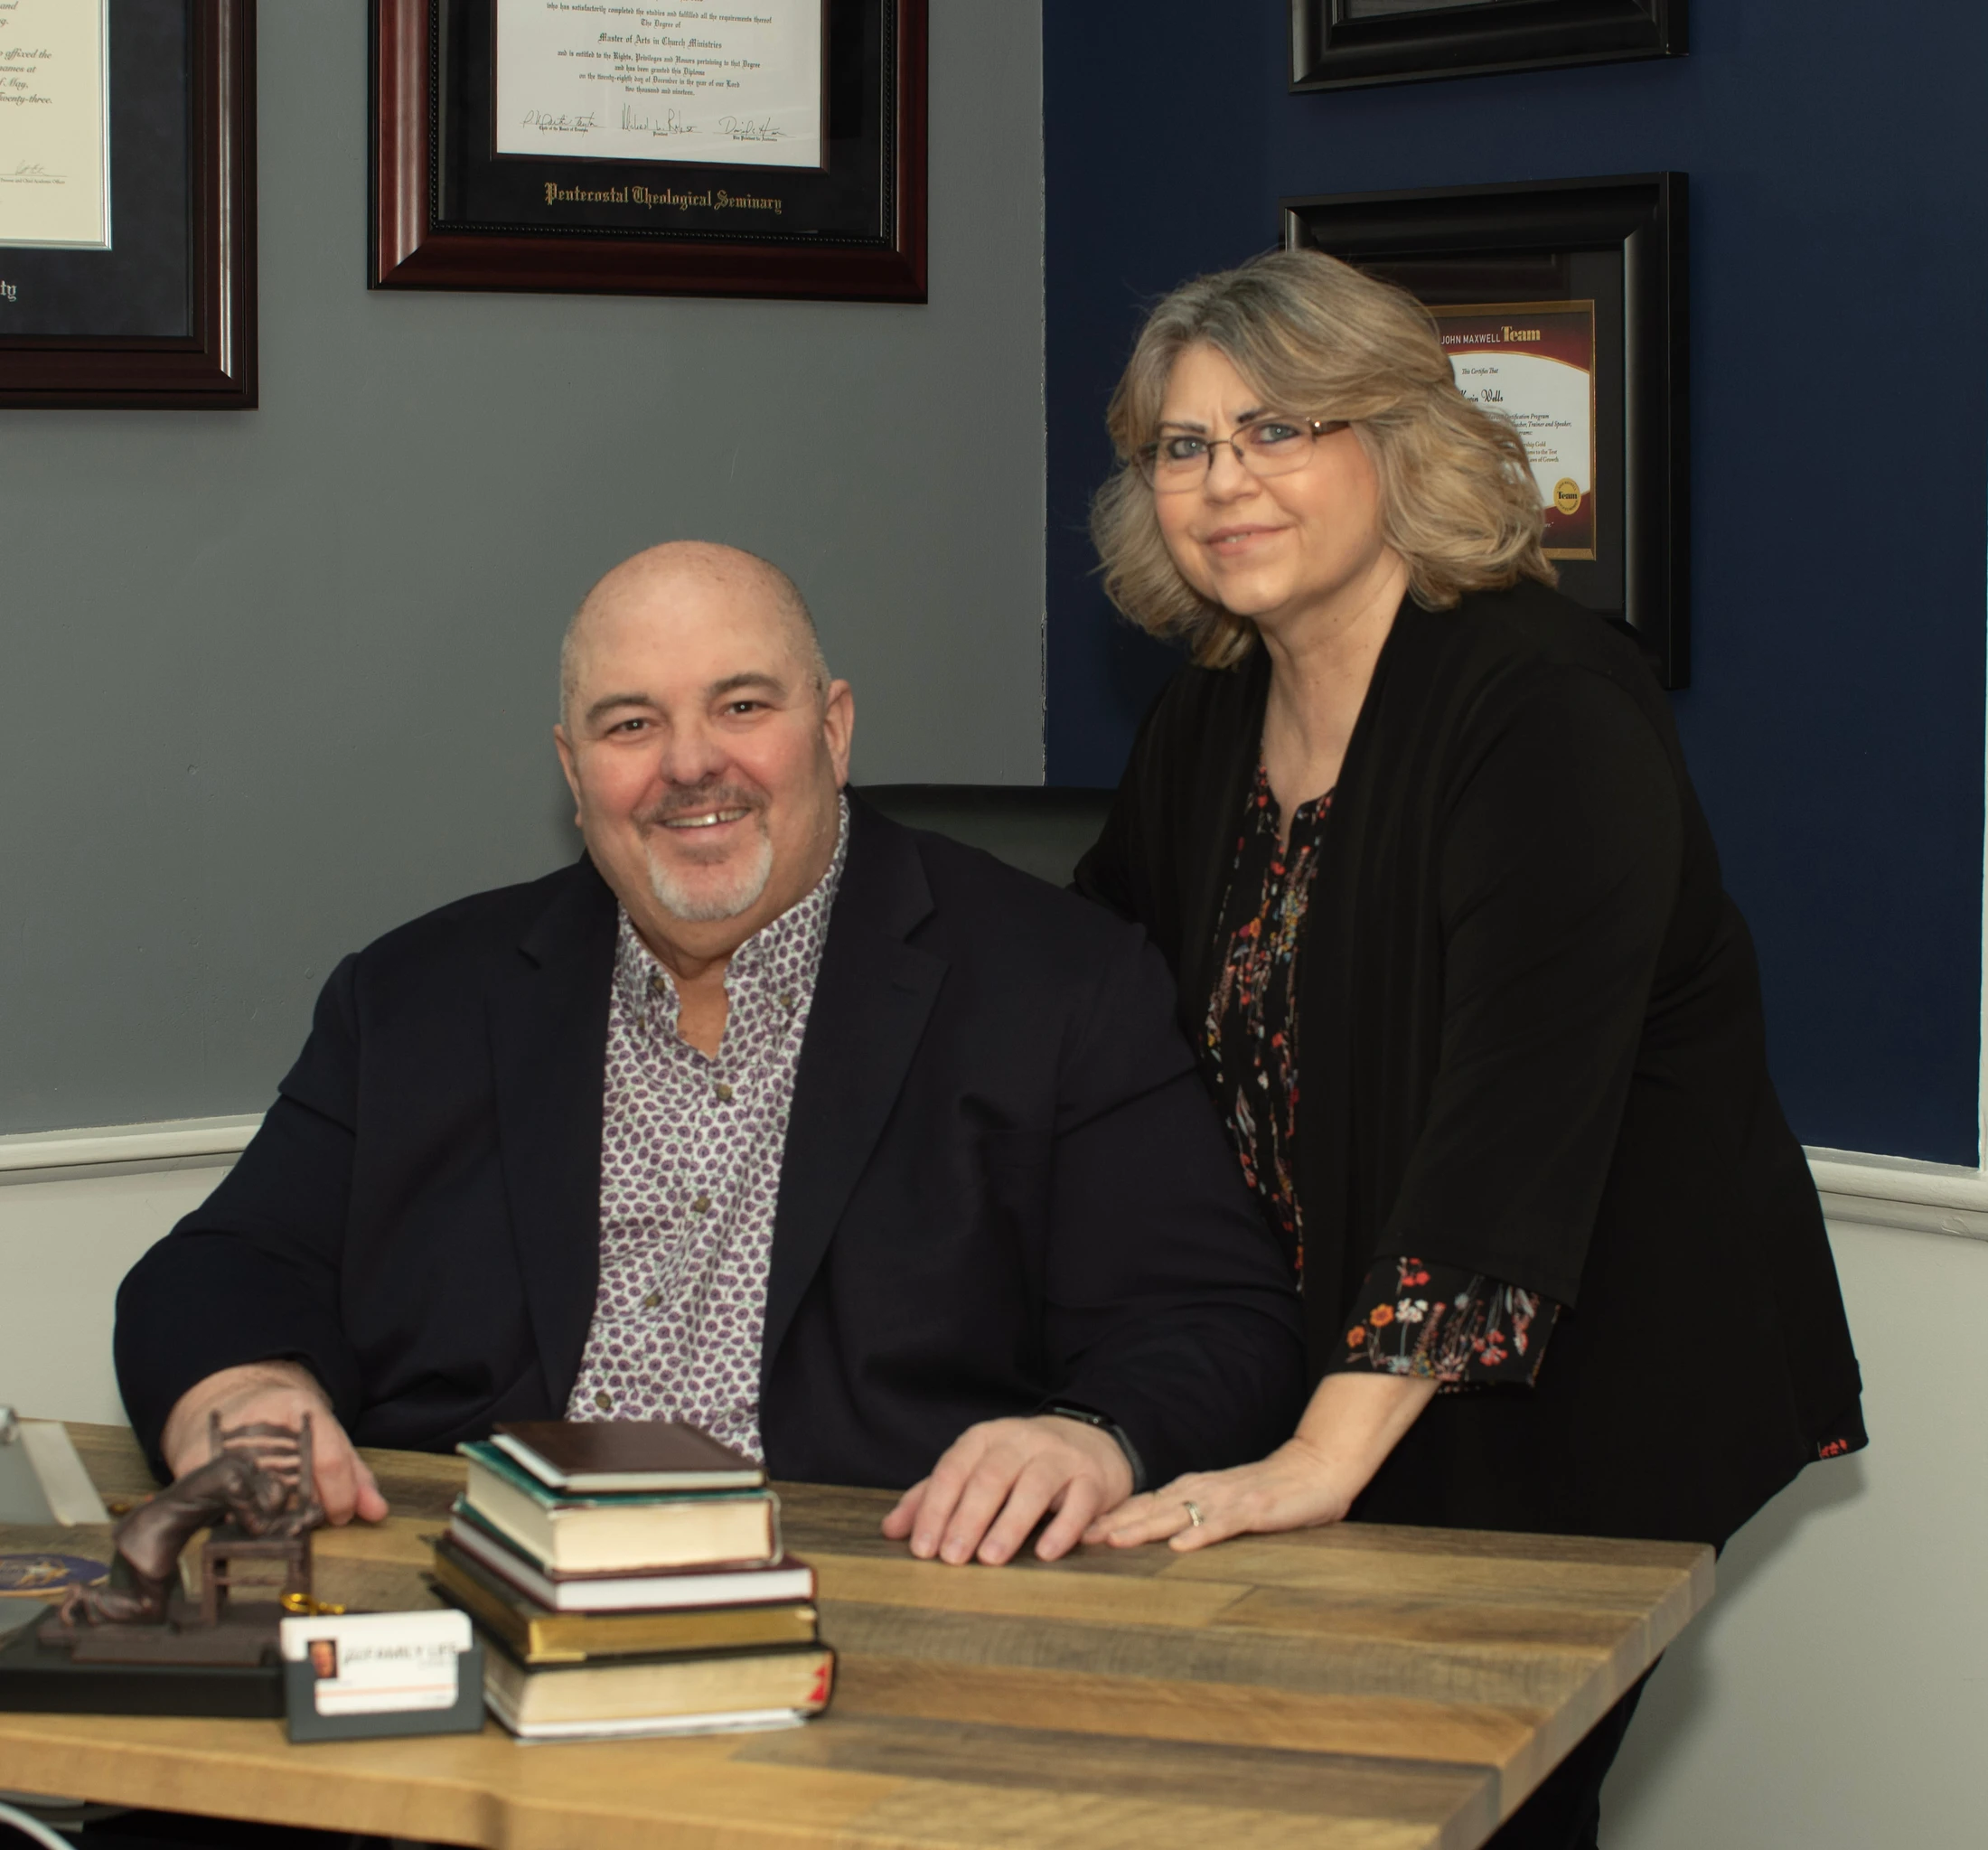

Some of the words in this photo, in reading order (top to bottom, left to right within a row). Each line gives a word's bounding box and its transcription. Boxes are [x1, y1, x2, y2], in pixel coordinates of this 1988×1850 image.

[546, 3, 558, 11] who
[560, 3, 569, 11] has
[571, 5, 606, 14] satisfactorily
[608, 7, 633, 15] completed
[667, 9, 677, 17] and
[719, 14, 752, 23] requirements
[754, 16, 773, 24] thereof
[641, 18, 652, 27] The
[653, 19, 673, 29] Degree
[598, 33, 624, 43] Master
[626, 34, 633, 43] of
[634, 34, 651, 45] Arts
[653, 37, 660, 45] in
[661, 37, 686, 49] Church
[688, 38, 722, 50] Ministries
[5, 47, 38, 61] affixed
[39, 49, 52, 59] the
[614, 52, 633, 62] Rights,
[635, 53, 662, 63] Privileges
[675, 55, 695, 64] Honors
[697, 58, 722, 68] pertaining
[731, 60, 741, 68] that
[742, 60, 761, 70] Degree
[626, 64, 635, 72] has
[651, 67, 670, 75] granted
[671, 67, 681, 75] this
[683, 67, 705, 77] Diploma
[587, 73, 595, 81] the
[597, 74, 633, 83] twenty-eighth
[652, 76, 678, 85] December
[696, 80, 707, 88] year
[727, 80, 740, 89] Lord
[636, 86, 660, 94] thousand
[545, 183, 629, 206] Pentecostal
[633, 185, 712, 211] Theological
[714, 190, 783, 214] Seminary
[1441, 334, 1461, 345] JOHN
[1463, 333, 1500, 343] MAXWELL
[1501, 325, 1541, 342] Team
[1471, 368, 1488, 376] Certifies
[1481, 389, 1504, 402] Wells
[1530, 413, 1550, 421] Program
[1554, 420, 1572, 428] Speaker,
[1557, 491, 1578, 500] Team
